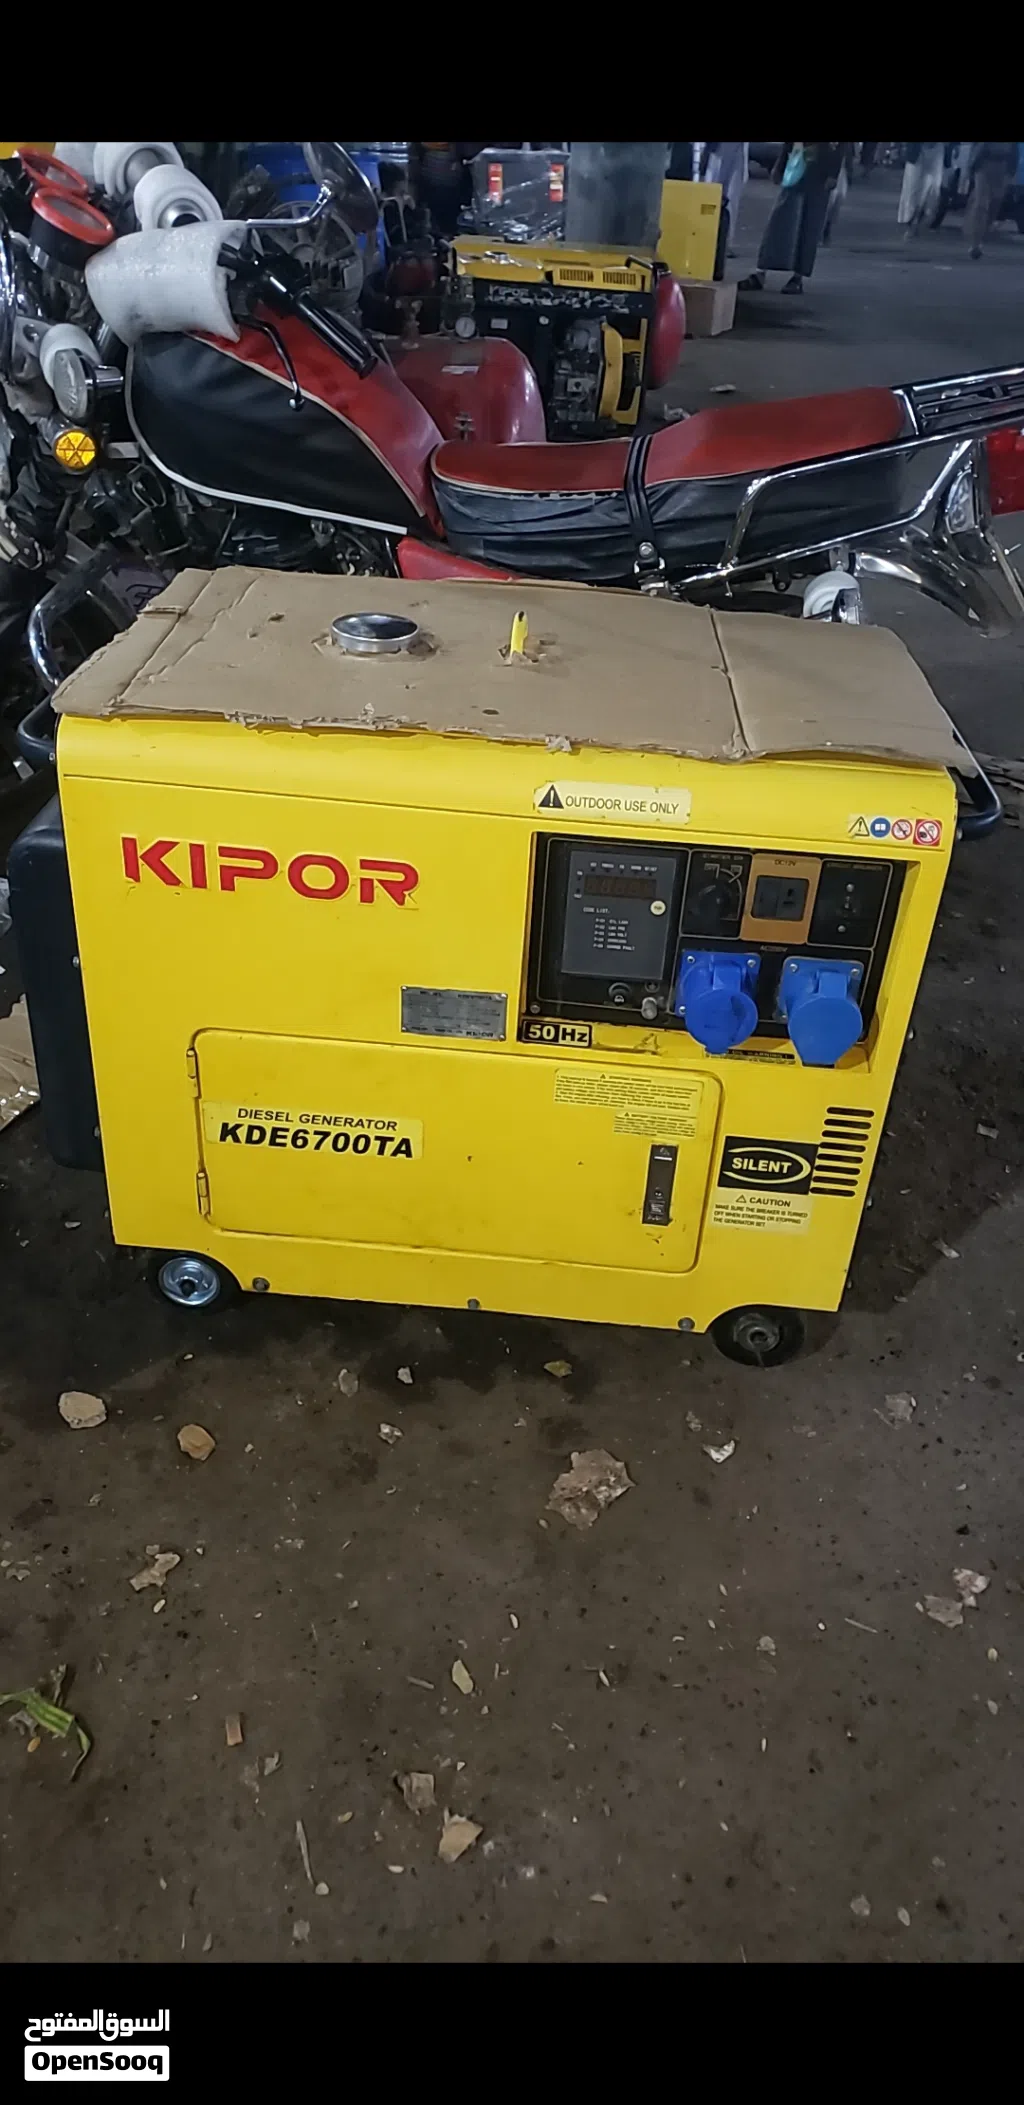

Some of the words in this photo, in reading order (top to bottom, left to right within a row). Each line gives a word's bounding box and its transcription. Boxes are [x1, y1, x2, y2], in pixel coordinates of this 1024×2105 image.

[565, 795, 621, 811] OUTDOOR
[624, 800, 646, 812] USE
[650, 801, 679, 814] ONLY
[120, 836, 419, 907] KIPOR
[528, 1023, 554, 1040] 50
[562, 1026, 588, 1043] Hz
[237, 1107, 294, 1123] DIESEL
[299, 1113, 398, 1131] GENERATOR
[219, 1122, 413, 1159] KDE6700TA
[732, 1157, 792, 1174] SILENT
[749, 1197, 791, 1207] CAUTION
[756, 1207, 780, 1215] BREAKER
[724, 1218, 755, 1226] GENERATOR
[742, 1213, 766, 1221] STARTING
